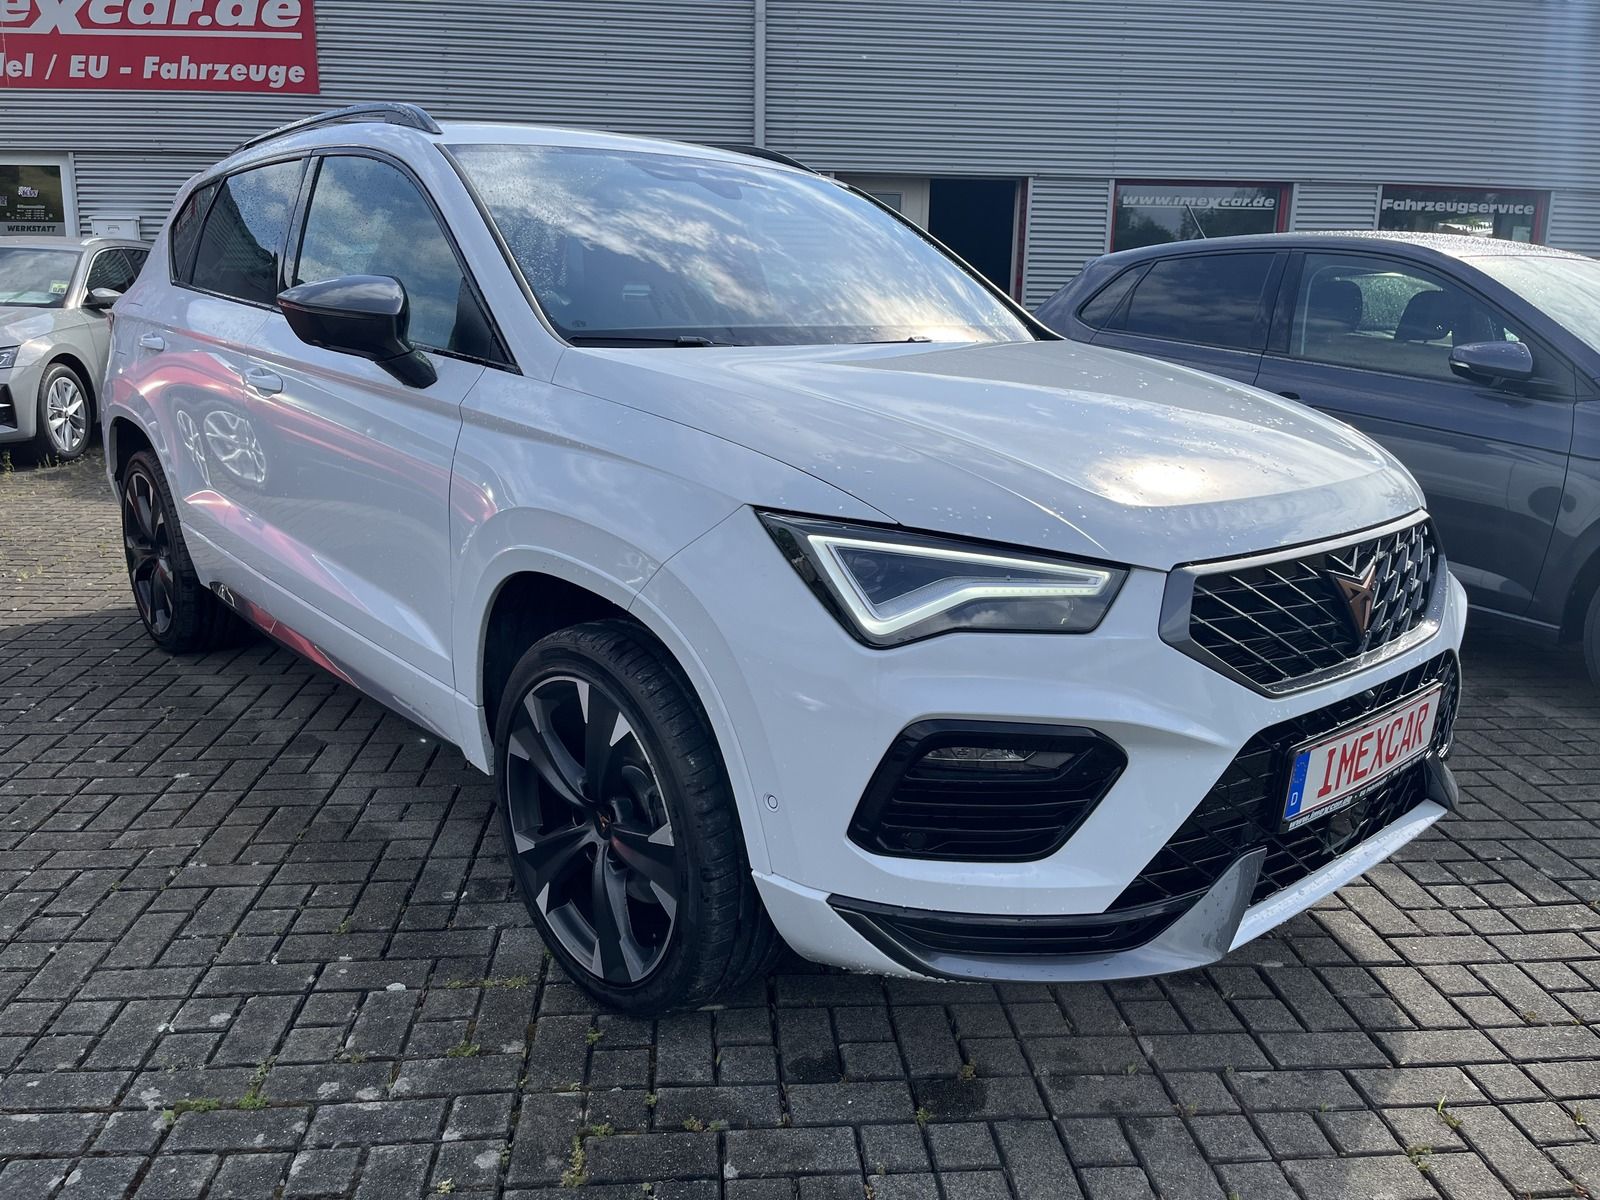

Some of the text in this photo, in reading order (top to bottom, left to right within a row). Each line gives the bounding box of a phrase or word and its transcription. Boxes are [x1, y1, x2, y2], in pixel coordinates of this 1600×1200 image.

[69, 55, 109, 79] EU
[143, 56, 305, 88] Fahrzeuge
[1122, 194, 1275, 209] www.imexcar.de
[1381, 198, 1535, 215] Fahrzeugservice
[7, 225, 56, 233] WERKSTATT
[1317, 702, 1430, 798] IMEXCAR
[1290, 791, 1299, 806] D
